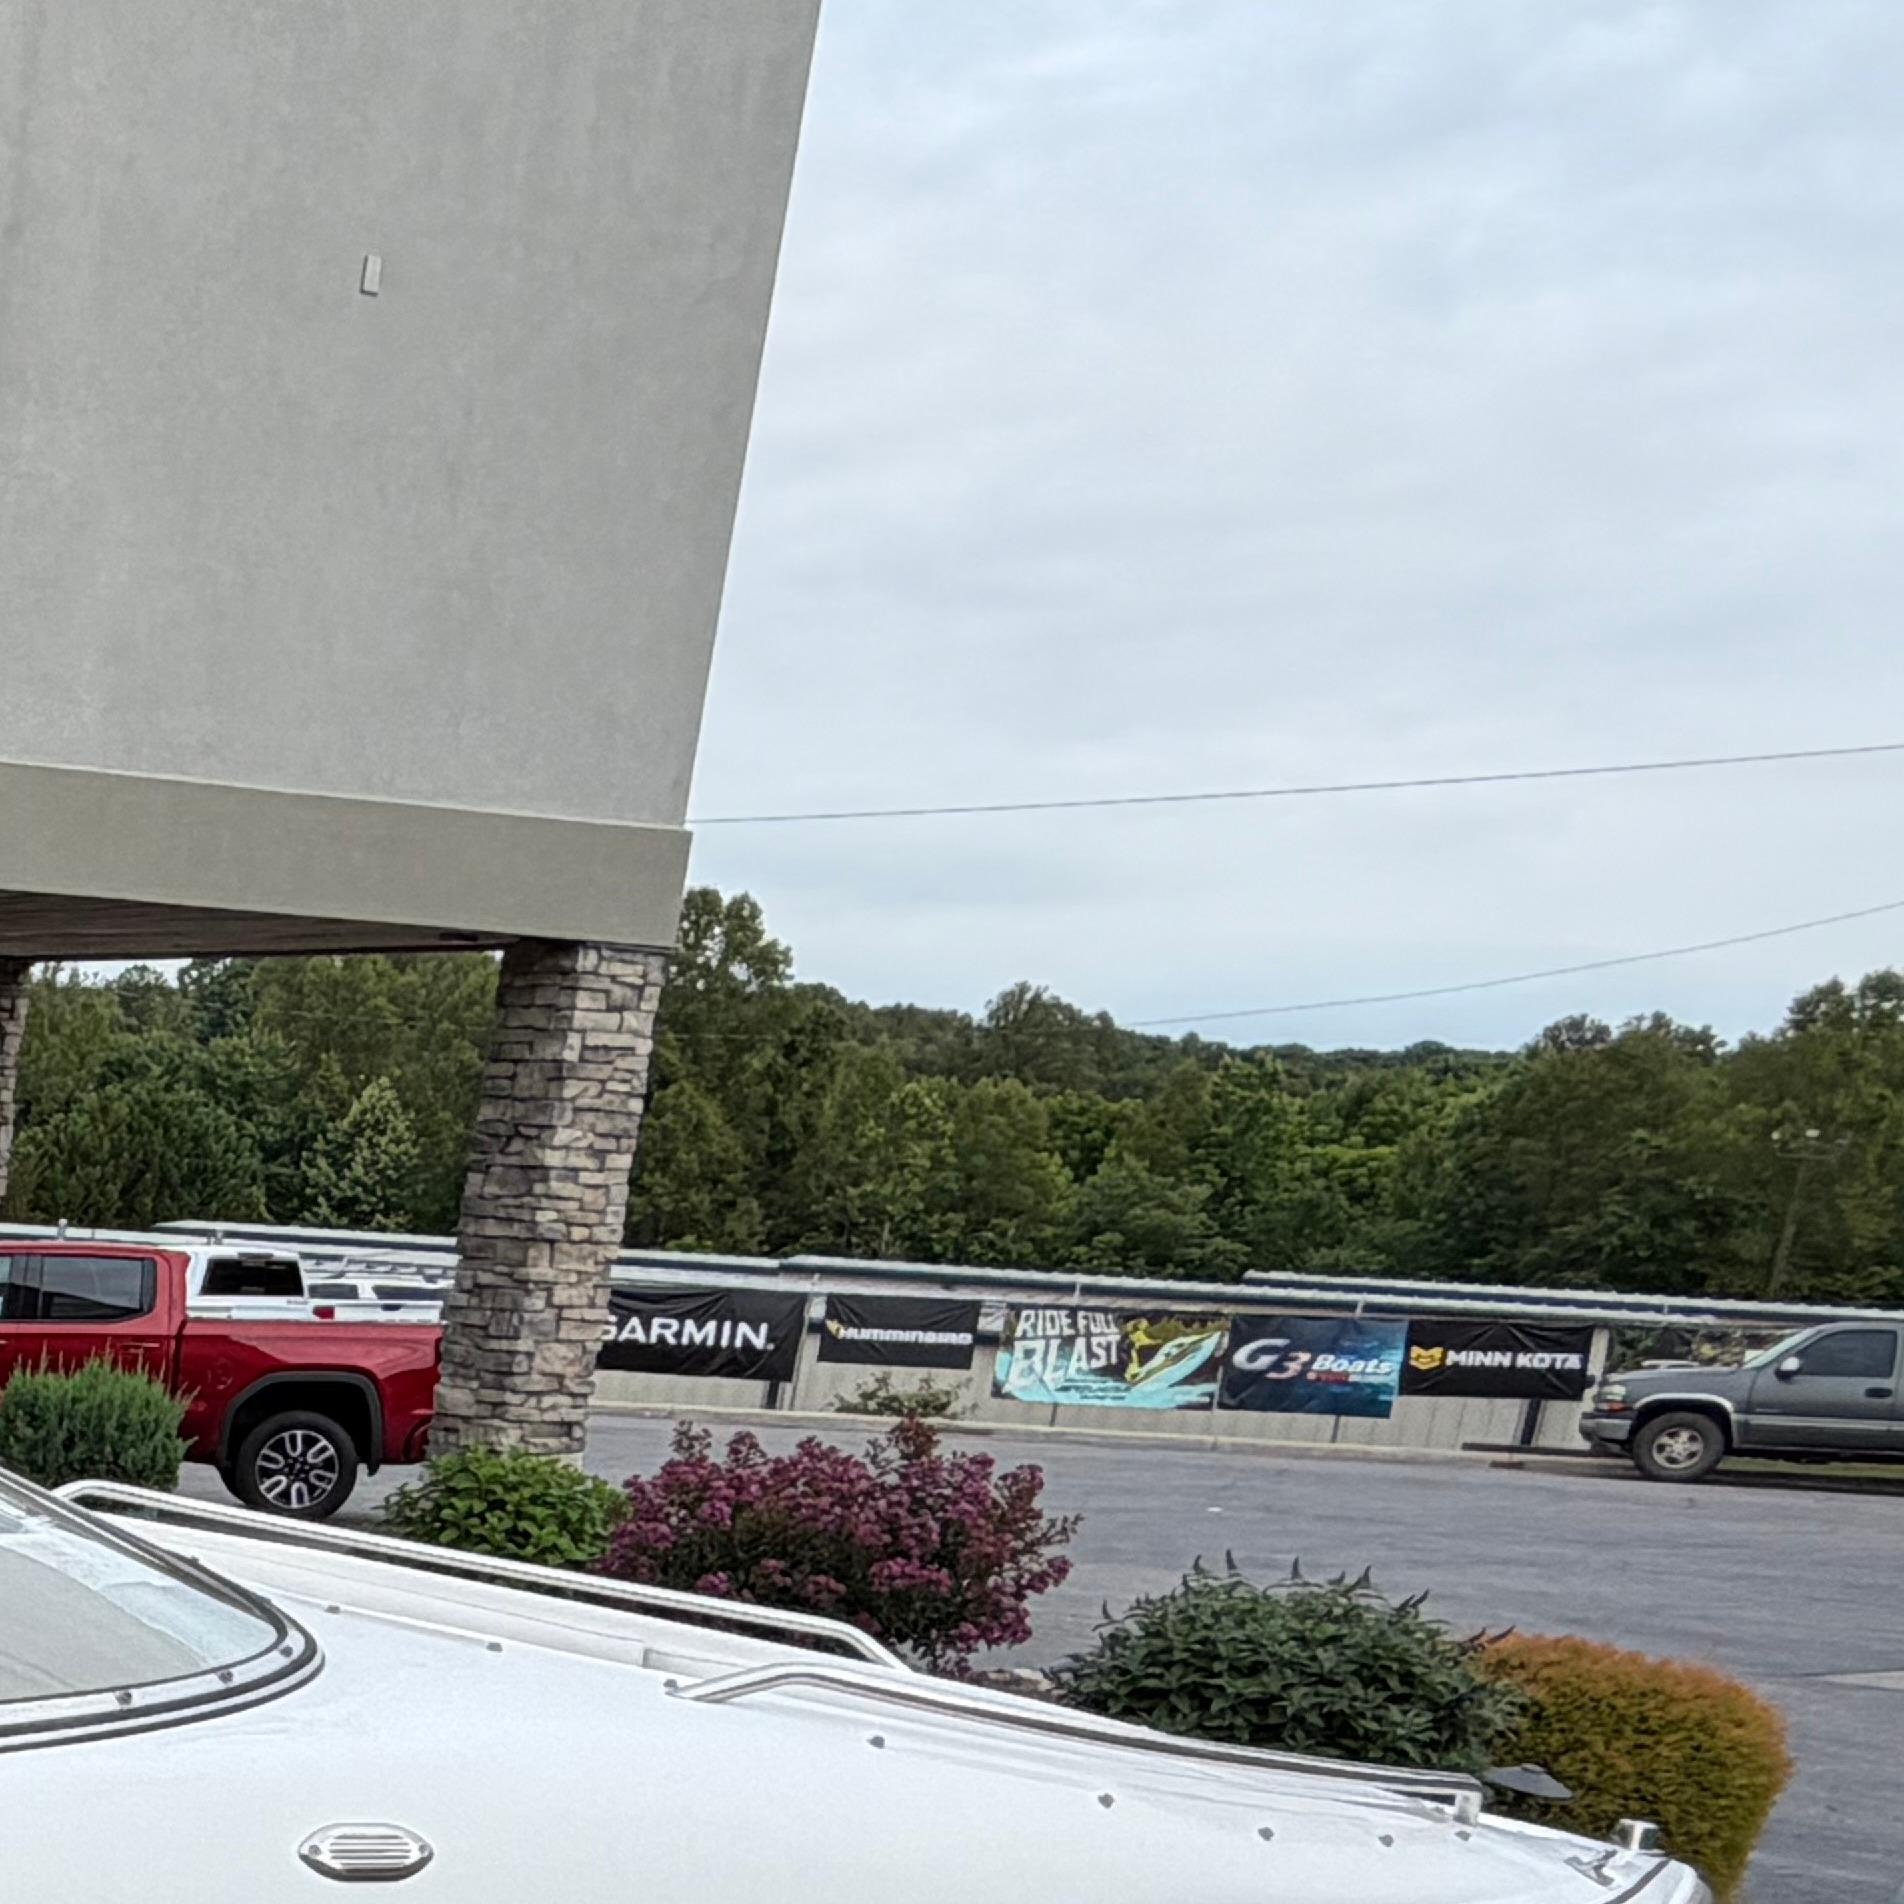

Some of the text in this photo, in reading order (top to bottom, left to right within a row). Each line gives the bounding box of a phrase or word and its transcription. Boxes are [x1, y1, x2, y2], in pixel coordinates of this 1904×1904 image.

[1014, 1309, 1121, 1338] RIDE FULL
[1002, 1334, 1122, 1393] BLAST
[1232, 1337, 1397, 1380] G3 Boats
[1446, 1350, 1584, 1370] MINN KOTA
